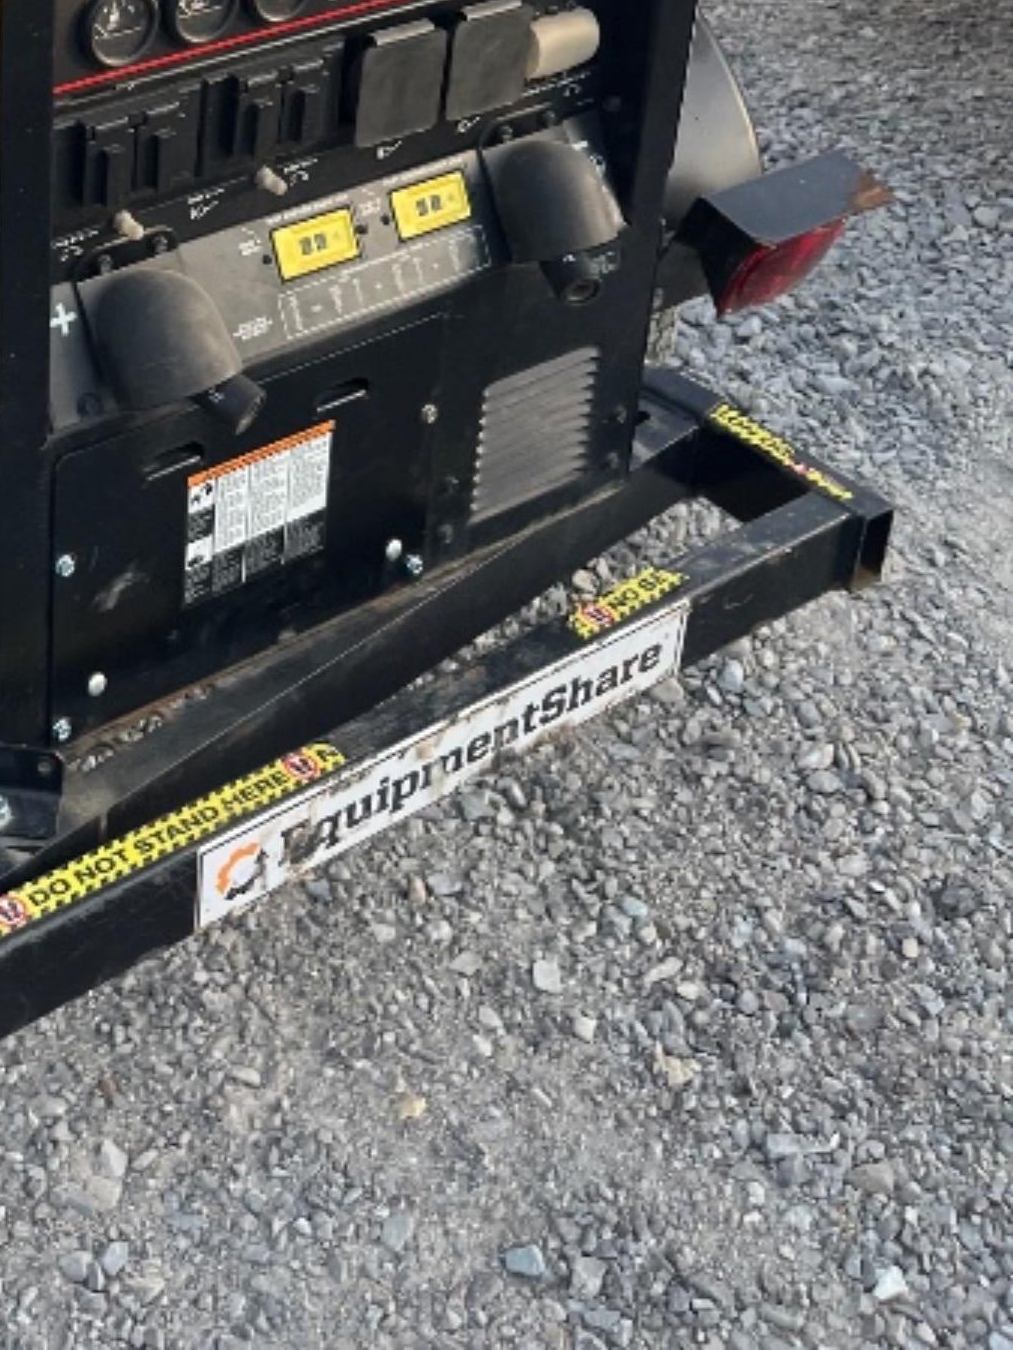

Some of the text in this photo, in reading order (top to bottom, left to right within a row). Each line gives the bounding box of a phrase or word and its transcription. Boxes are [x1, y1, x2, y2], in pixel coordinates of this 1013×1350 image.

[277, 641, 663, 866] EquipmentShare
[28, 877, 71, 908] DO
[74, 848, 130, 886] NOT
[133, 804, 220, 854] STAND
